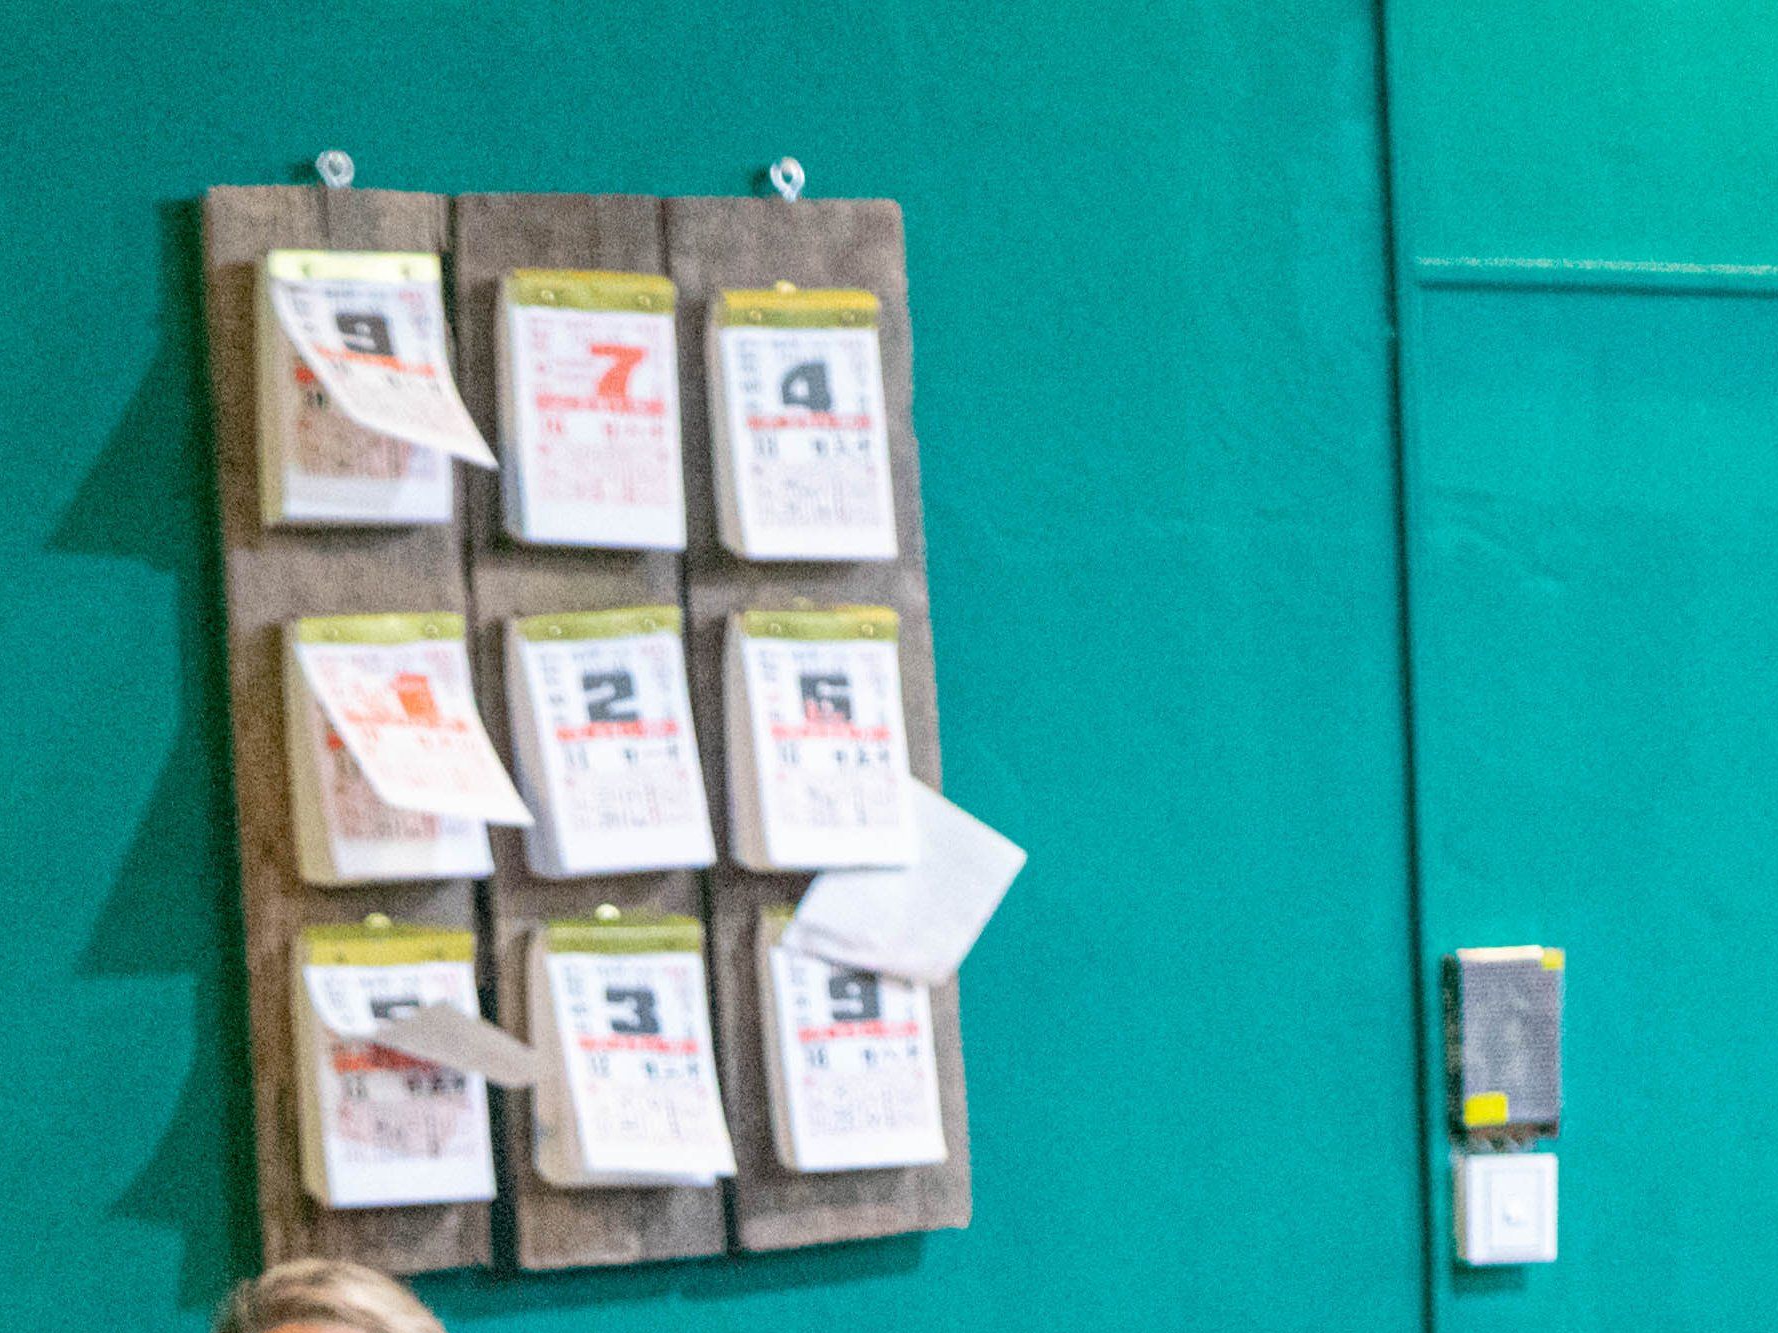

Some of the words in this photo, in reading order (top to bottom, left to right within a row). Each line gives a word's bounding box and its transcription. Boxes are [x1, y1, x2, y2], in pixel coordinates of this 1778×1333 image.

[590, 343, 647, 400] 7
[781, 361, 834, 412] 4
[581, 671, 638, 723] 2
[605, 988, 660, 1036] 3
[828, 966, 881, 1021] 9
